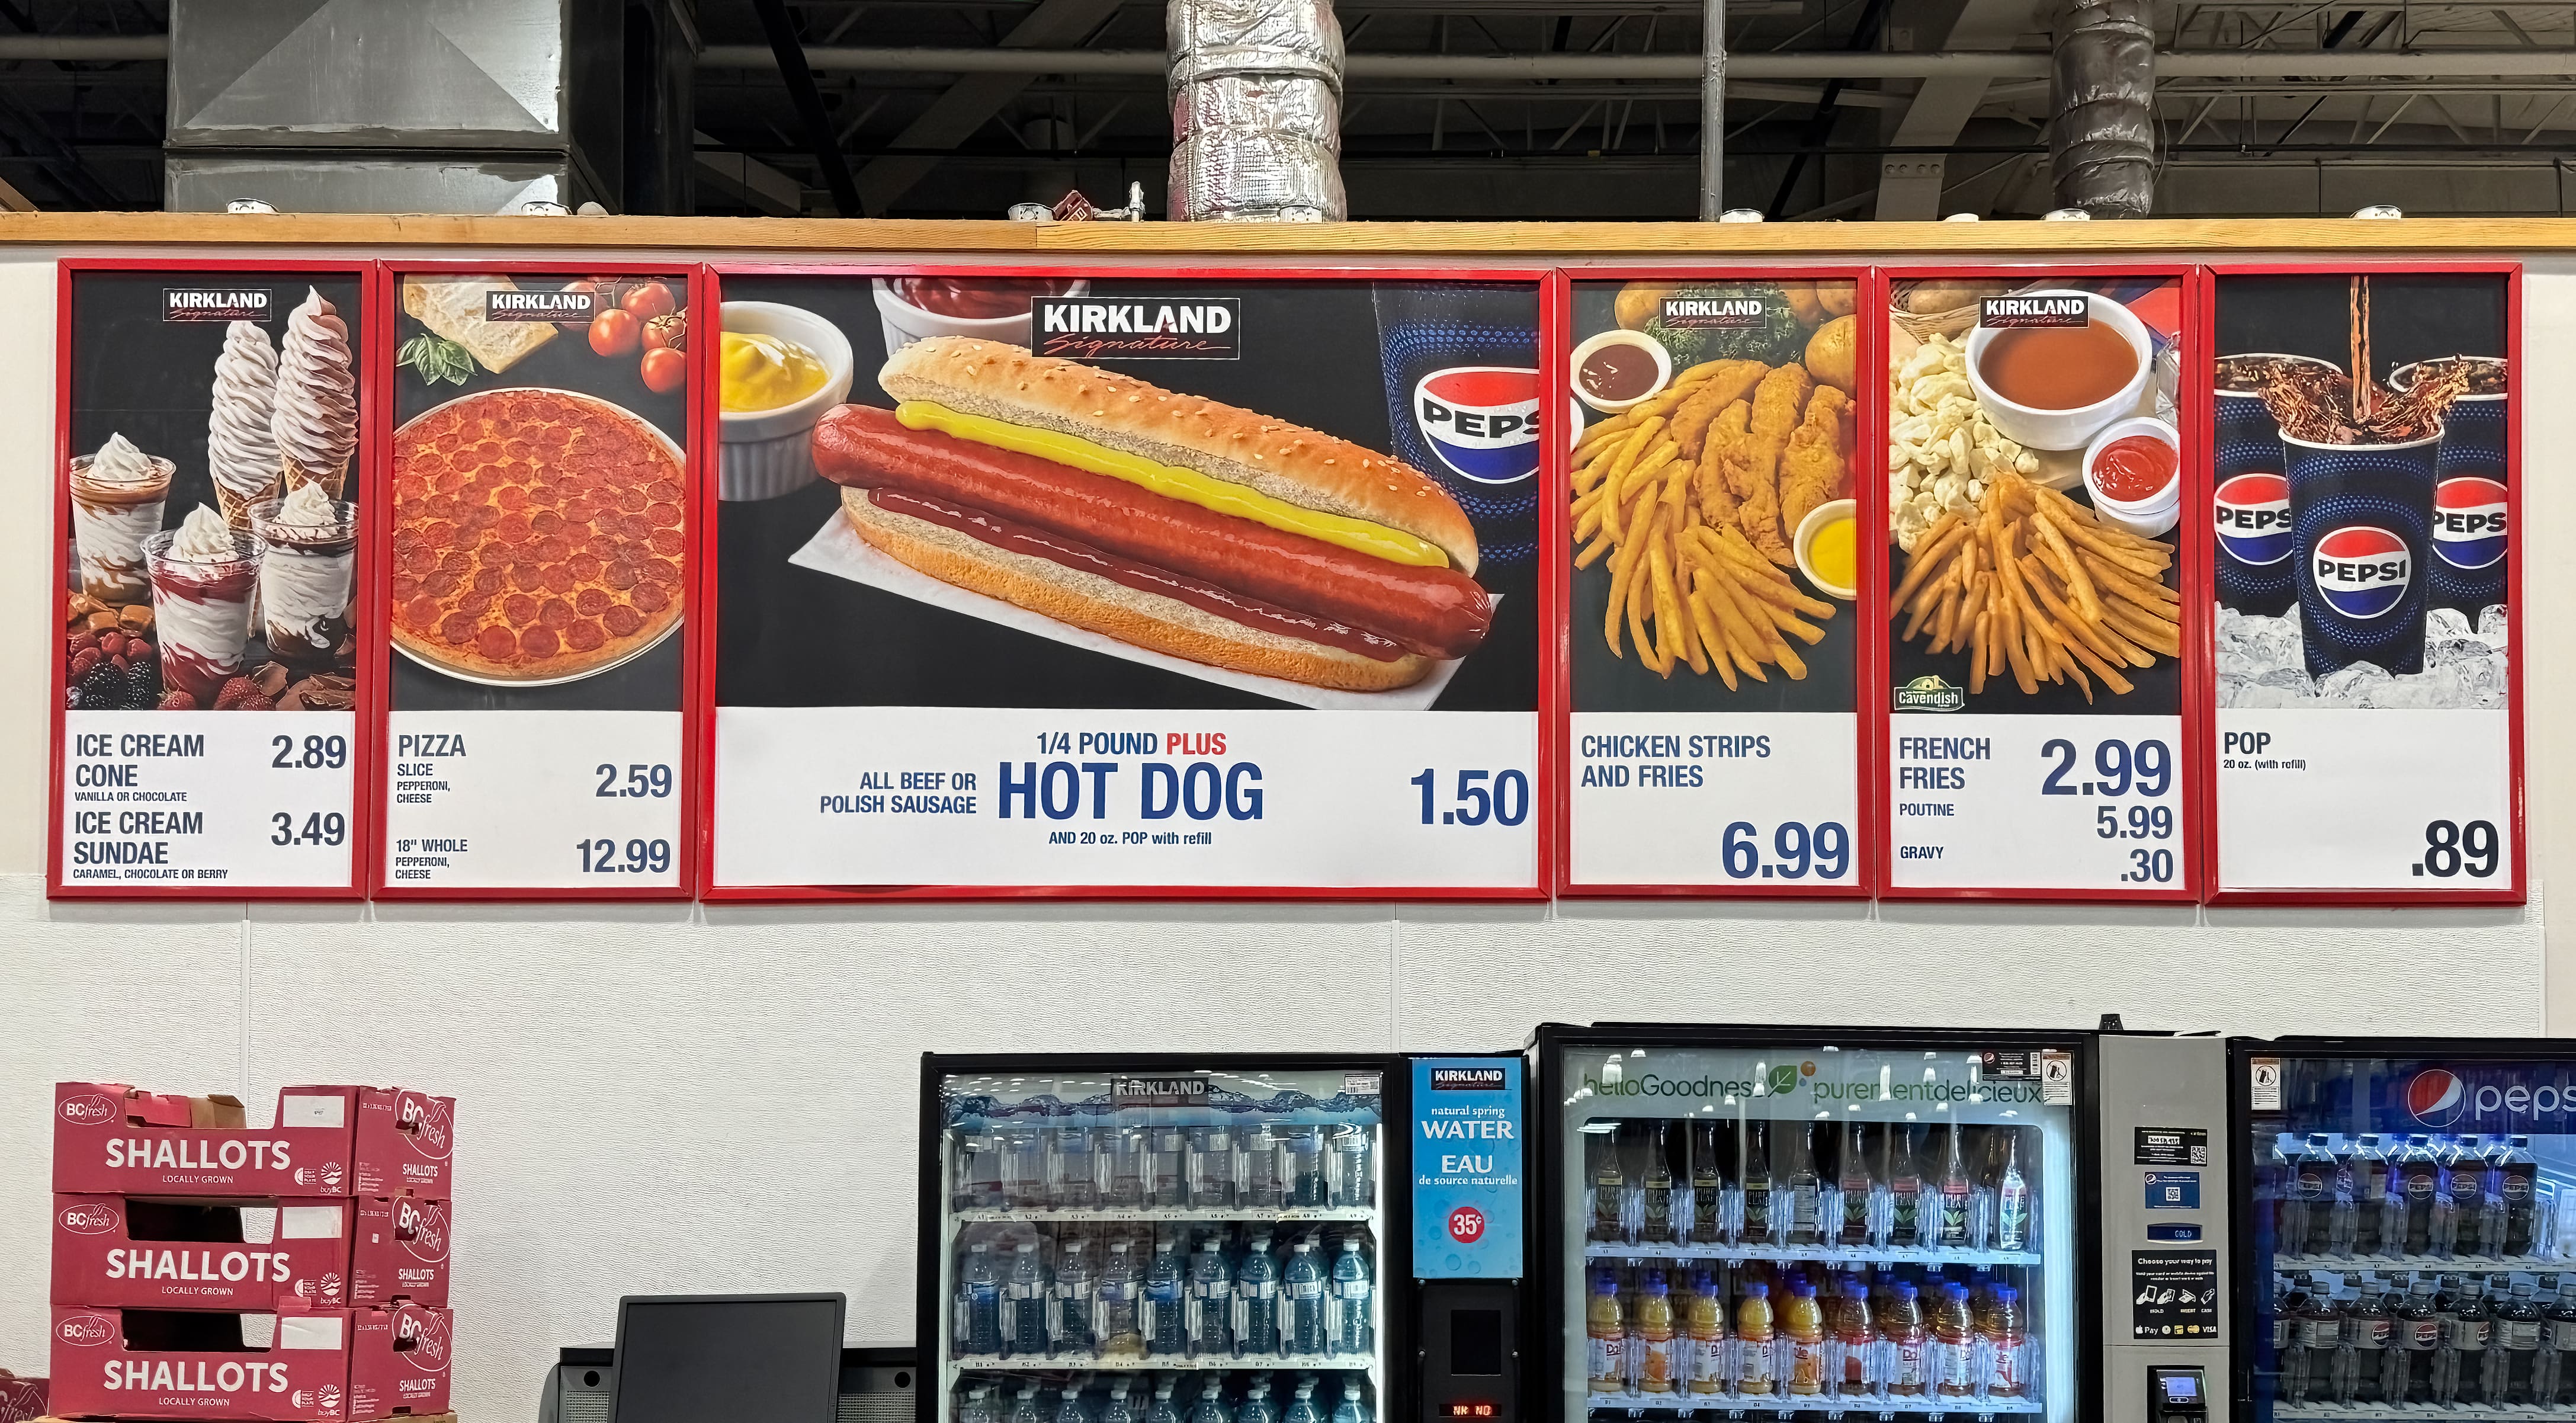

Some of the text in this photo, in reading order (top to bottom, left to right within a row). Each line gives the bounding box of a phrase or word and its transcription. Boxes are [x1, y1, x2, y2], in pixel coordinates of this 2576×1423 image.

[169, 293, 267, 307] KIRKLAND
[492, 294, 591, 309] KIRKLAND
[1666, 301, 1762, 316] KIRKLAND
[1987, 300, 2084, 315] KIRKLAND
[1044, 305, 1231, 334] KIRKLAND
[1044, 333, 1231, 357] Signature
[2216, 505, 2292, 529] PEPS
[2433, 512, 2507, 533] PEPS
[2318, 558, 2406, 582] PEPSI
[1899, 692, 1958, 704] Cavendish
[76, 734, 204, 757] ICE CREAM
[271, 735, 347, 768] 2.89
[398, 735, 466, 757] PIZZA
[1038, 732, 1227, 755] 1/4 POUND PLUS
[1581, 735, 1771, 758] CHICKEN STRIPS
[1900, 738, 1990, 760] FRENCH
[2224, 732, 2271, 754] POP
[397, 764, 434, 777] SLICE
[2041, 739, 2171, 797] 2.99
[2224, 759, 2235, 769] 20
[2238, 760, 2251, 769] oz.
[2254, 759, 2278, 770] (with
[76, 764, 139, 787] CONE
[595, 764, 672, 798] 2.59
[860, 772, 976, 791] ALL BEEF OR
[1581, 765, 1704, 787] AND FRIES
[1900, 767, 1965, 790] FRIES
[75, 792, 187, 802] VANILLA OR CHOCOLATE
[397, 781, 451, 793] PEPPERONI,
[999, 761, 1263, 821] HOT DOG
[397, 794, 432, 803] CHEESE
[820, 795, 977, 814] POLISH SAUSAGE
[1410, 768, 1529, 828] 1.50
[1900, 803, 1954, 816] POUTINE
[75, 811, 203, 835] ICE CREAM
[271, 812, 345, 846] 3.49
[2097, 805, 2173, 839] 5.99
[396, 839, 468, 852] 18" WHOLE
[1049, 831, 1212, 845] AND 20 oz. POP with refill
[2412, 819, 2499, 877] .89
[73, 841, 169, 864] SUNDAE
[576, 839, 671, 873] 12.99
[1722, 821, 1849, 879] 6.99
[1900, 846, 1943, 859] GRAVY
[396, 857, 450, 868] PEPPERONI,
[2121, 849, 2173, 883] .30
[73, 869, 228, 880] CARAMEL, CHOCOLATE OR BERRY
[395, 870, 431, 879] CHEESE
[1435, 1070, 1502, 1081] KIRKLAND
[1584, 1073, 1764, 1097] helloGoodnes
[1116, 1081, 1204, 1095] KIRKLAND
[1432, 1105, 1505, 1118] natural spring
[2475, 1085, 2576, 1120] peps
[1422, 1120, 1514, 1139] WATER
[105, 1139, 291, 1171] SHALLOTS
[1442, 1155, 1493, 1173] EAU
[162, 1175, 233, 1184] LOCALLY GROWN
[403, 1164, 438, 1177] SHALLOTS
[1419, 1175, 1431, 1185] de
[1471, 1174, 1518, 1185] naturelle
[105, 1251, 291, 1283] SHALLOTS
[398, 1268, 434, 1280] SHALLOTS
[161, 1286, 233, 1295] LOCALLY GROWN
[103, 1360, 289, 1393] SHALLOTS
[399, 1379, 436, 1392] SHALLOTS
[158, 1397, 230, 1407] LOCALLY GROWN
